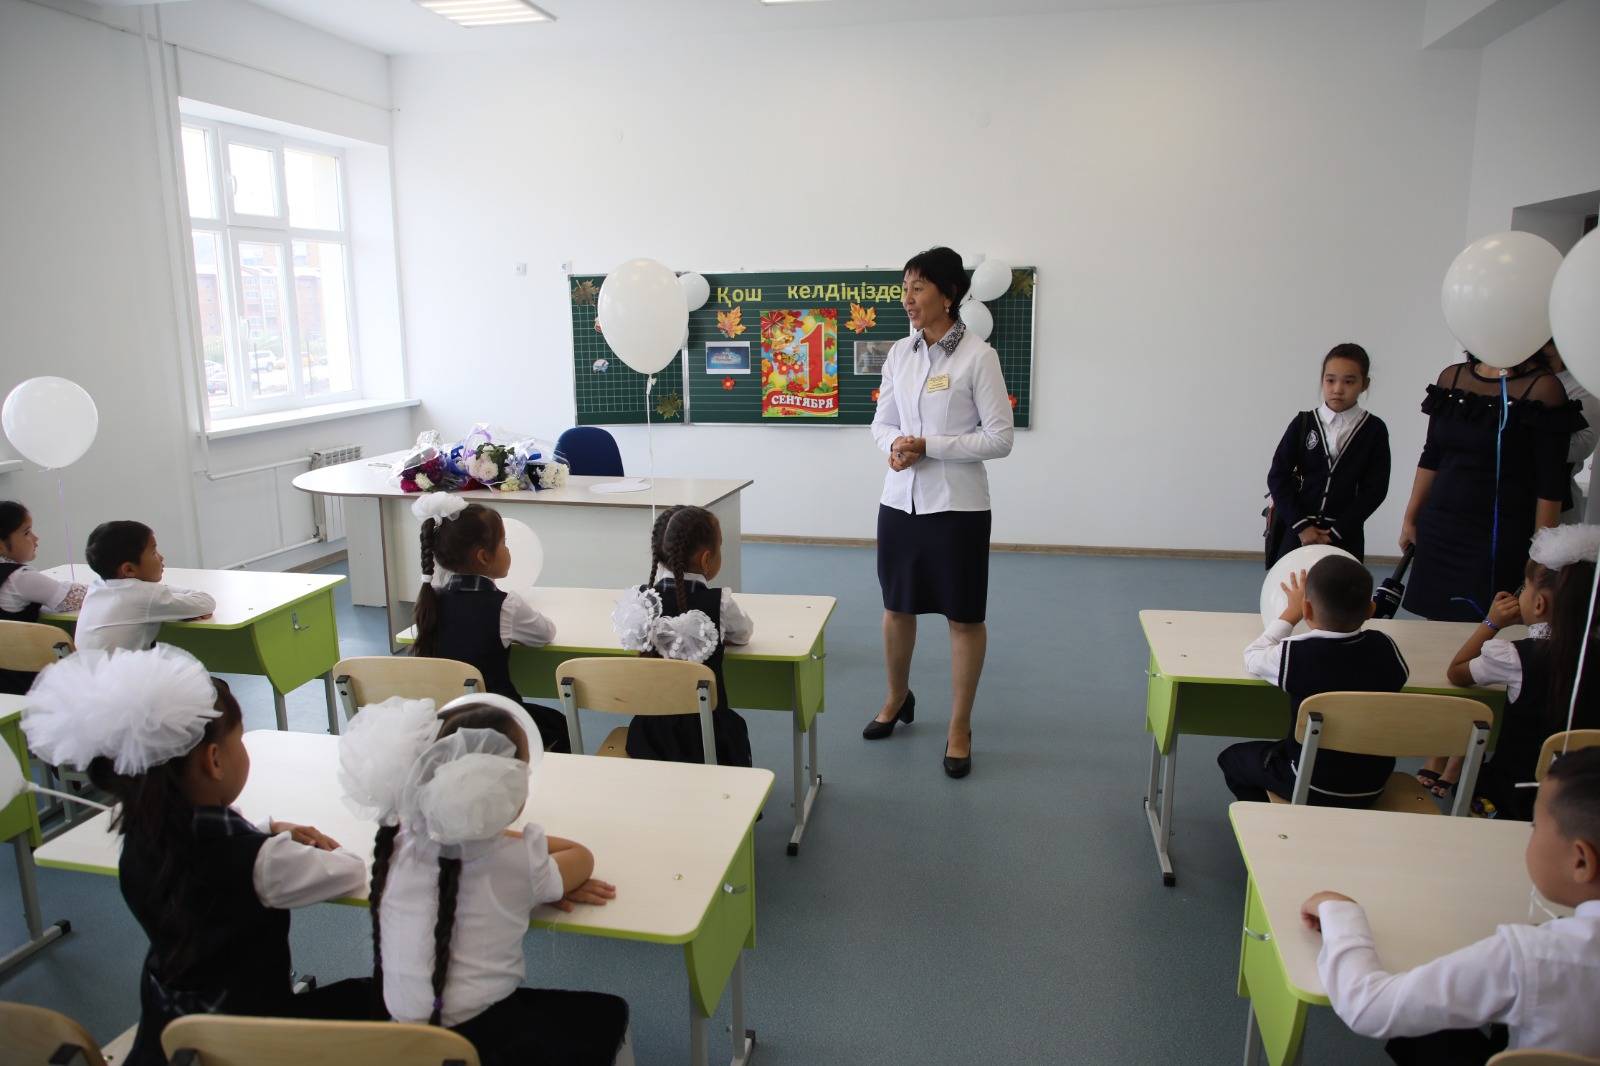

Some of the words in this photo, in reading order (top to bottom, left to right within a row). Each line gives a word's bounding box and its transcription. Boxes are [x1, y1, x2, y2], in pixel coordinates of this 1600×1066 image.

[717, 286, 762, 307] Қош
[800, 321, 824, 391] 1
[771, 394, 834, 409] СЕНТЯБРЯ
